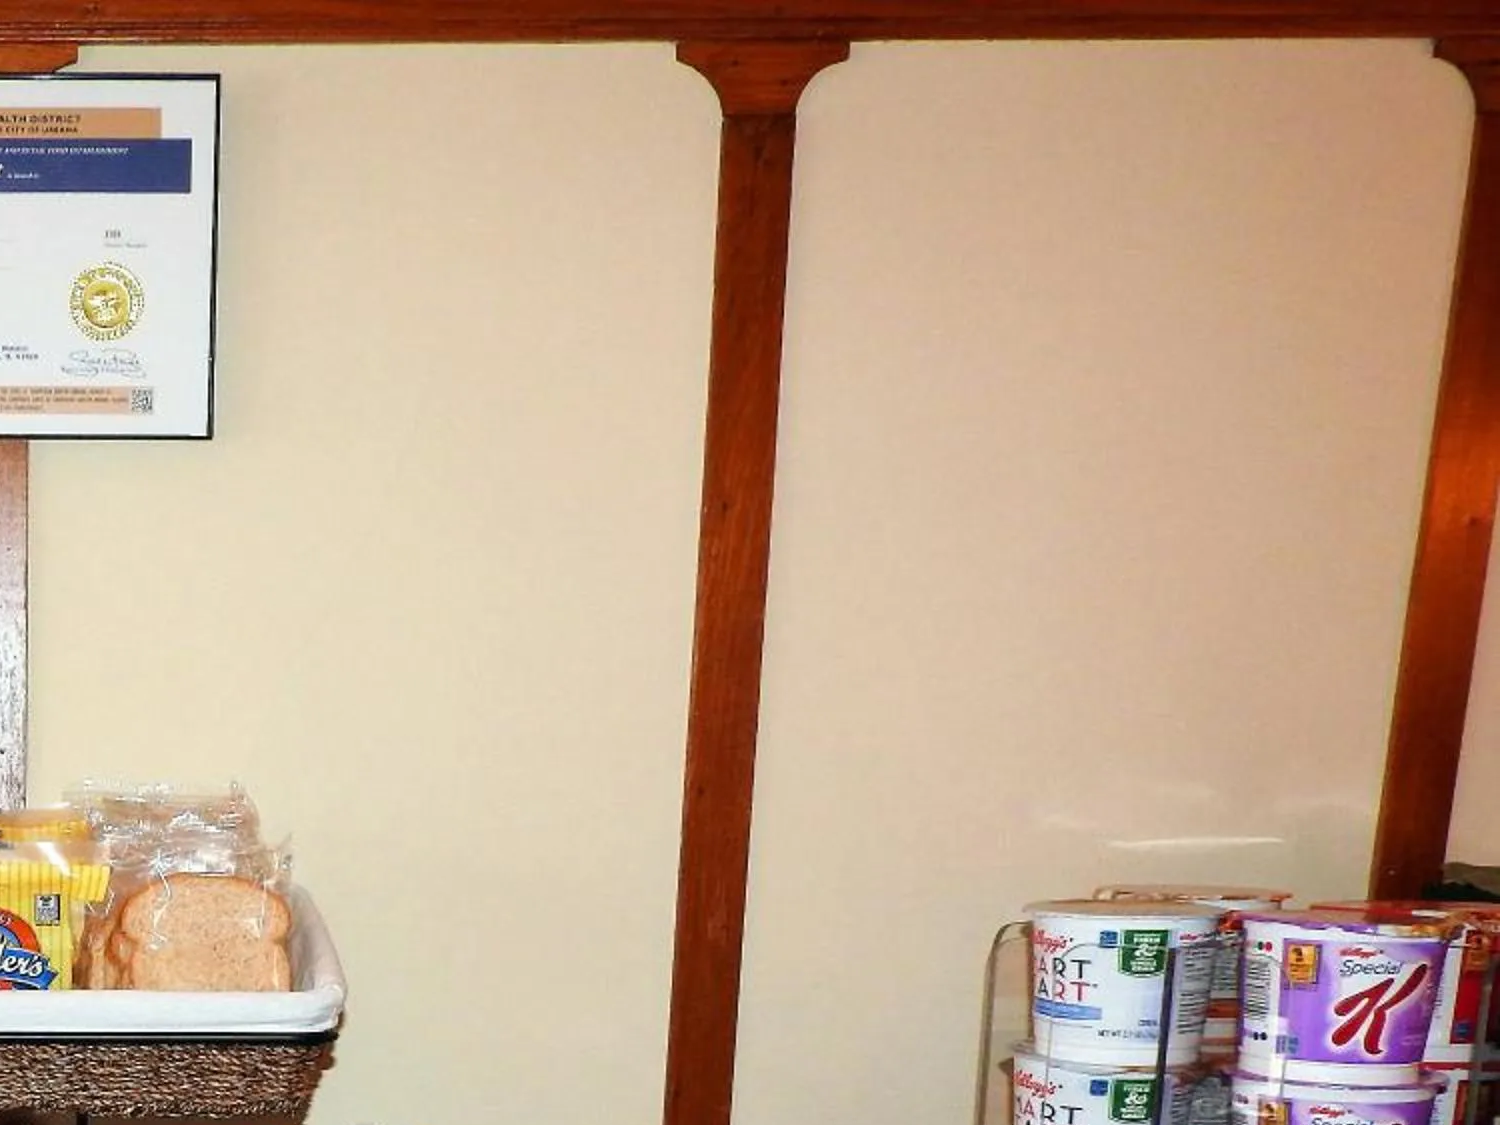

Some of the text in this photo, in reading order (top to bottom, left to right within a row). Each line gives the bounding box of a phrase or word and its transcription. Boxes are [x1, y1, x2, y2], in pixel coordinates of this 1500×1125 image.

[29, 114, 81, 124] DISTRICT
[1340, 959, 1403, 977] Special
[1331, 963, 1429, 1055] K
